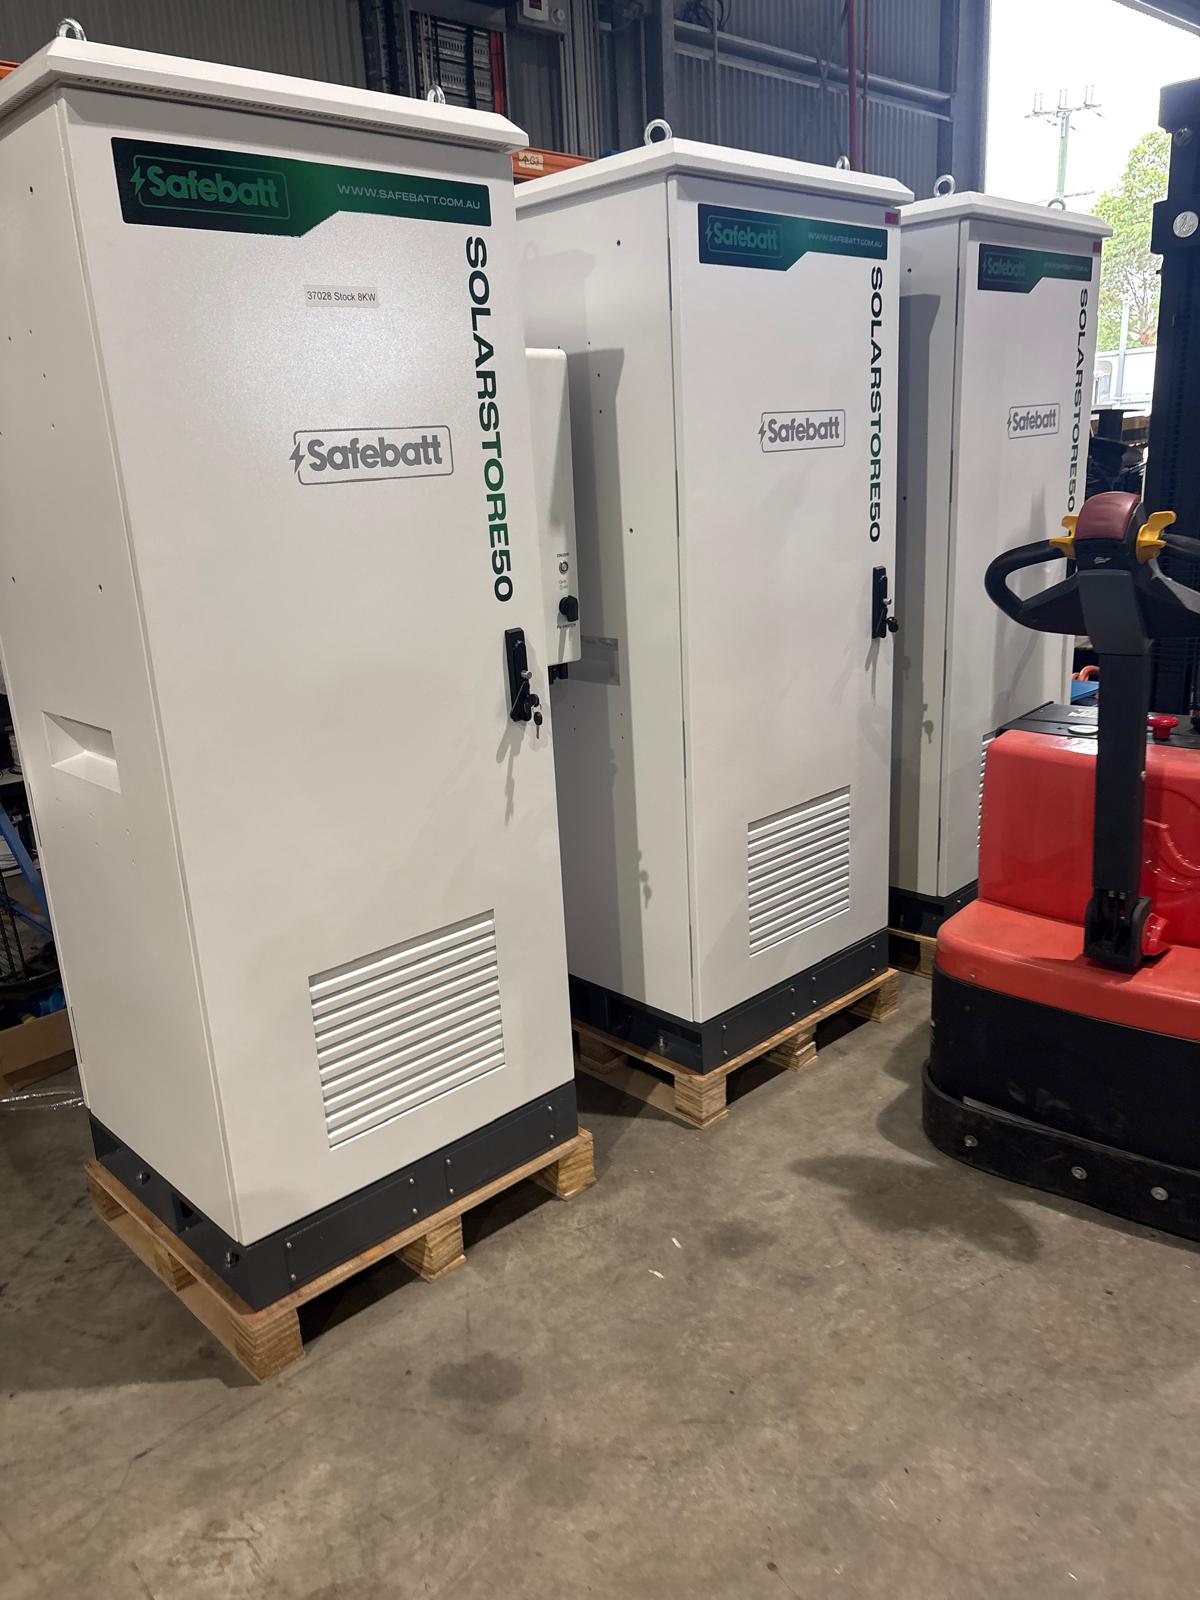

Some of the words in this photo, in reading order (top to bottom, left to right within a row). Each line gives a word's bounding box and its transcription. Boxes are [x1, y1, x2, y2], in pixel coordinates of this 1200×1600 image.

[148, 164, 280, 208] Safebatt
[337, 183, 481, 209] WWW.SAFEBATT.COM.AU
[713, 221, 777, 251] Safebatt
[306, 290, 332, 302] 37028
[333, 291, 356, 302] Stock
[357, 291, 376, 303] 8KW
[869, 265, 883, 543] SOLARSTORE50
[1067, 288, 1088, 513] SOLARSTORE50
[465, 236, 515, 602] SOLARSTORE50
[767, 416, 840, 443] Safebatt
[1012, 411, 1056, 433] Safebatt
[307, 434, 443, 472] Safebatt
